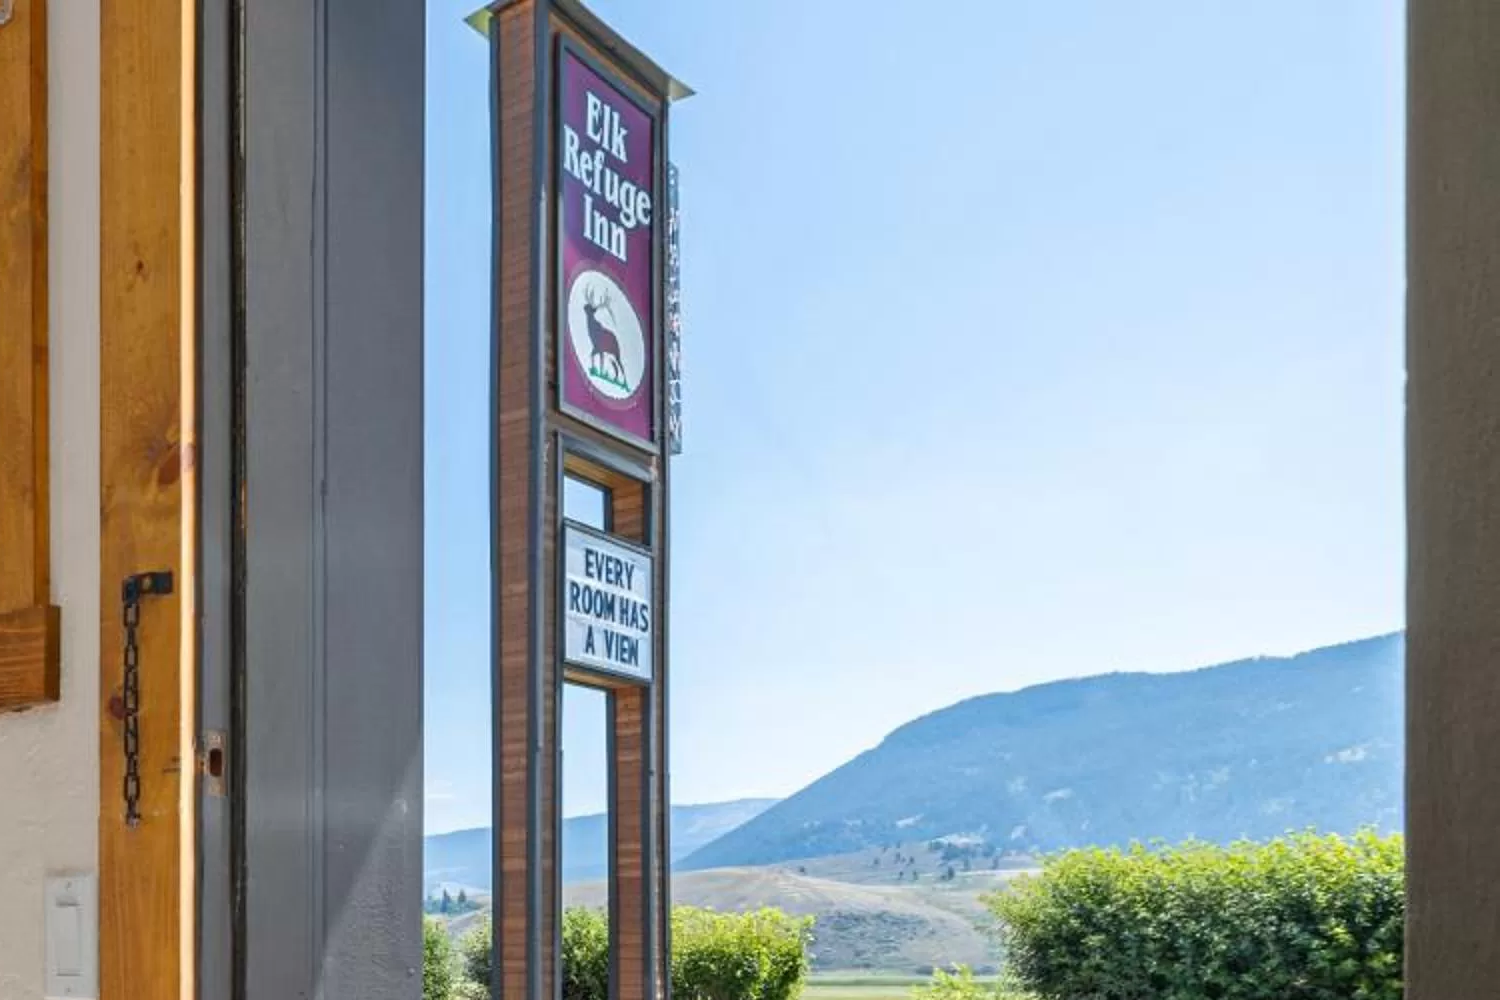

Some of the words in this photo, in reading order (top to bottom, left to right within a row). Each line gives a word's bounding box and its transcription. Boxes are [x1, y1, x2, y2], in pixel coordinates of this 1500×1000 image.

[586, 91, 628, 163] Elk
[563, 124, 651, 229] Refuge
[583, 193, 628, 262] Inn
[585, 548, 634, 590] EVERY
[570, 581, 615, 622] ROOM
[620, 596, 649, 632] HAS
[585, 624, 595, 656] A
